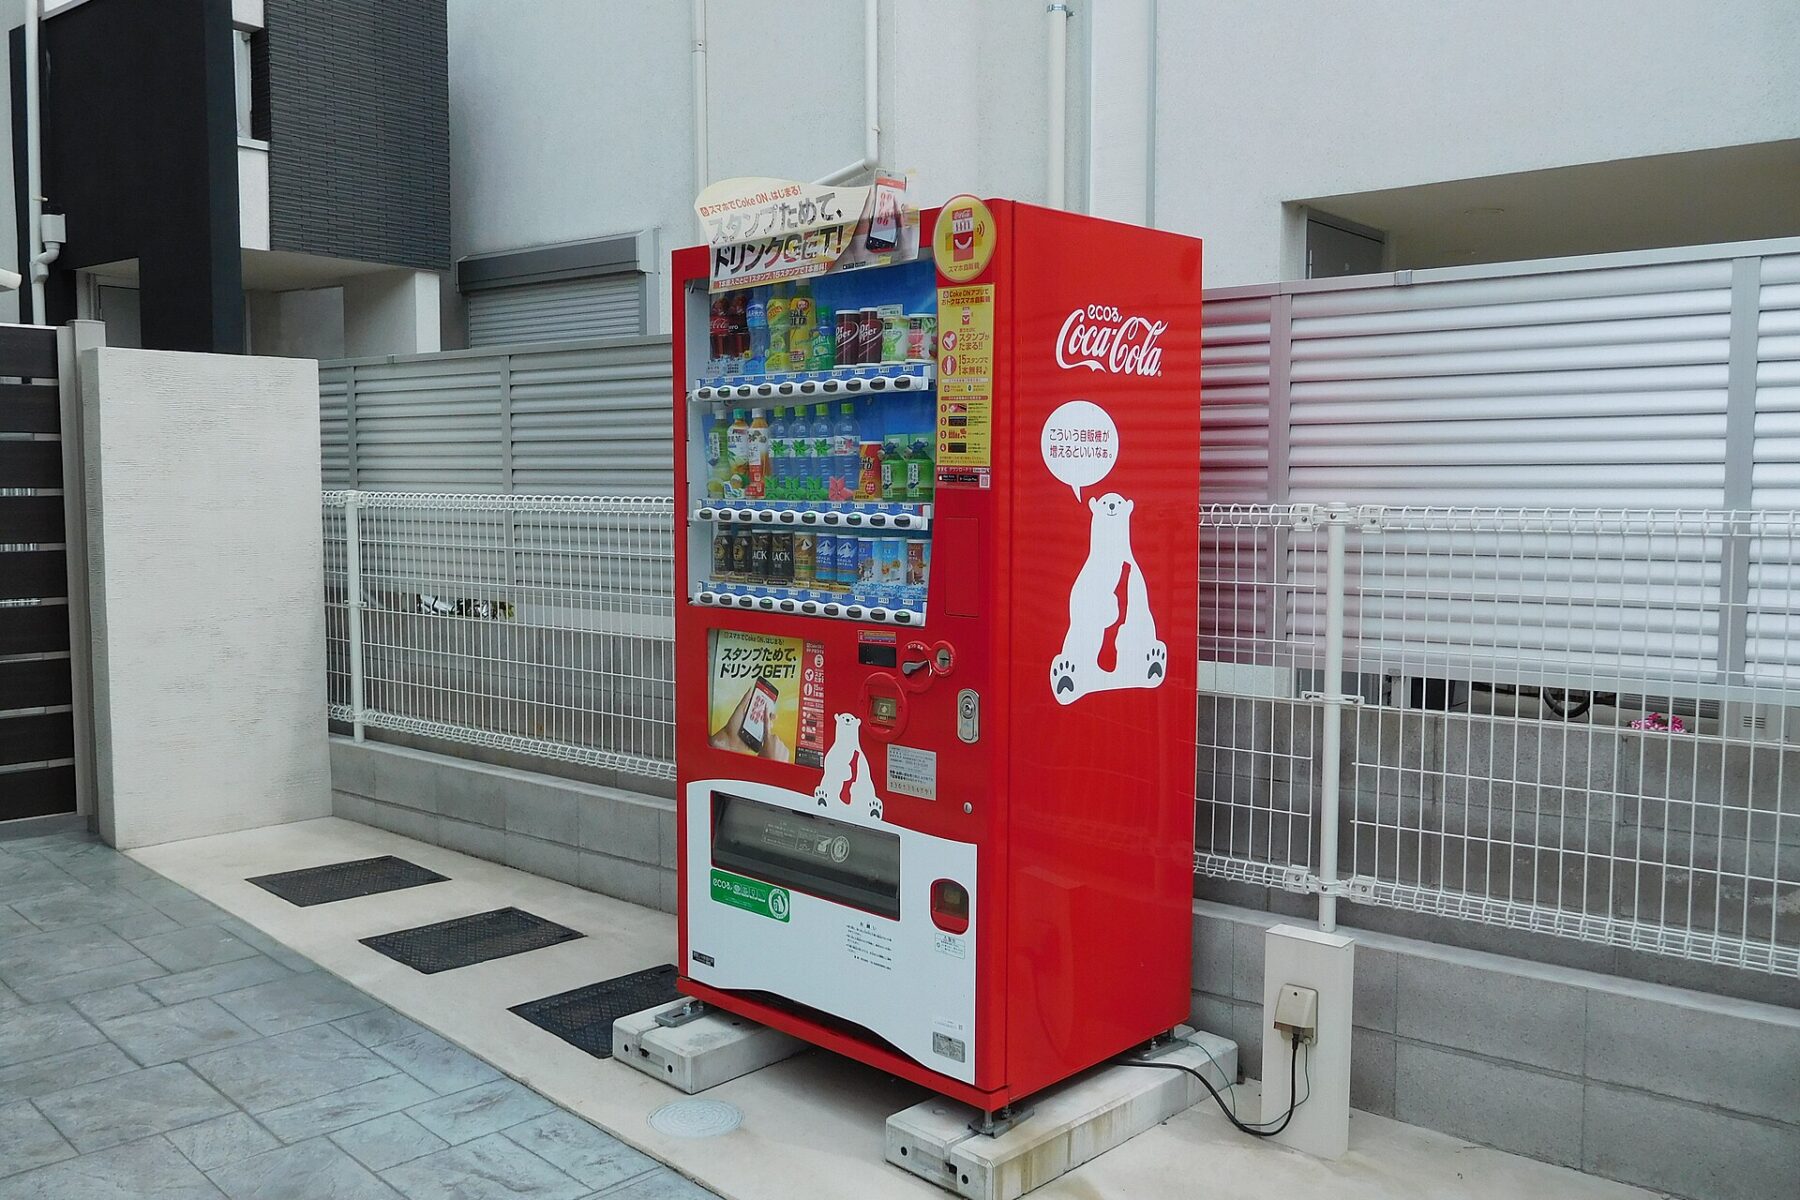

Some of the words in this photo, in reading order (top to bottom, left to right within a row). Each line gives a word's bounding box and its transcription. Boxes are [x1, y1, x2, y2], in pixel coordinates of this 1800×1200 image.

[714, 225, 844, 277] ドリンクGET!
[1055, 308, 1169, 377] Coca-Cola
[1049, 428, 1110, 443] こういう自販機が
[721, 647, 797, 661] スタンプためて、
[719, 663, 796, 679] ドリンクGET!
